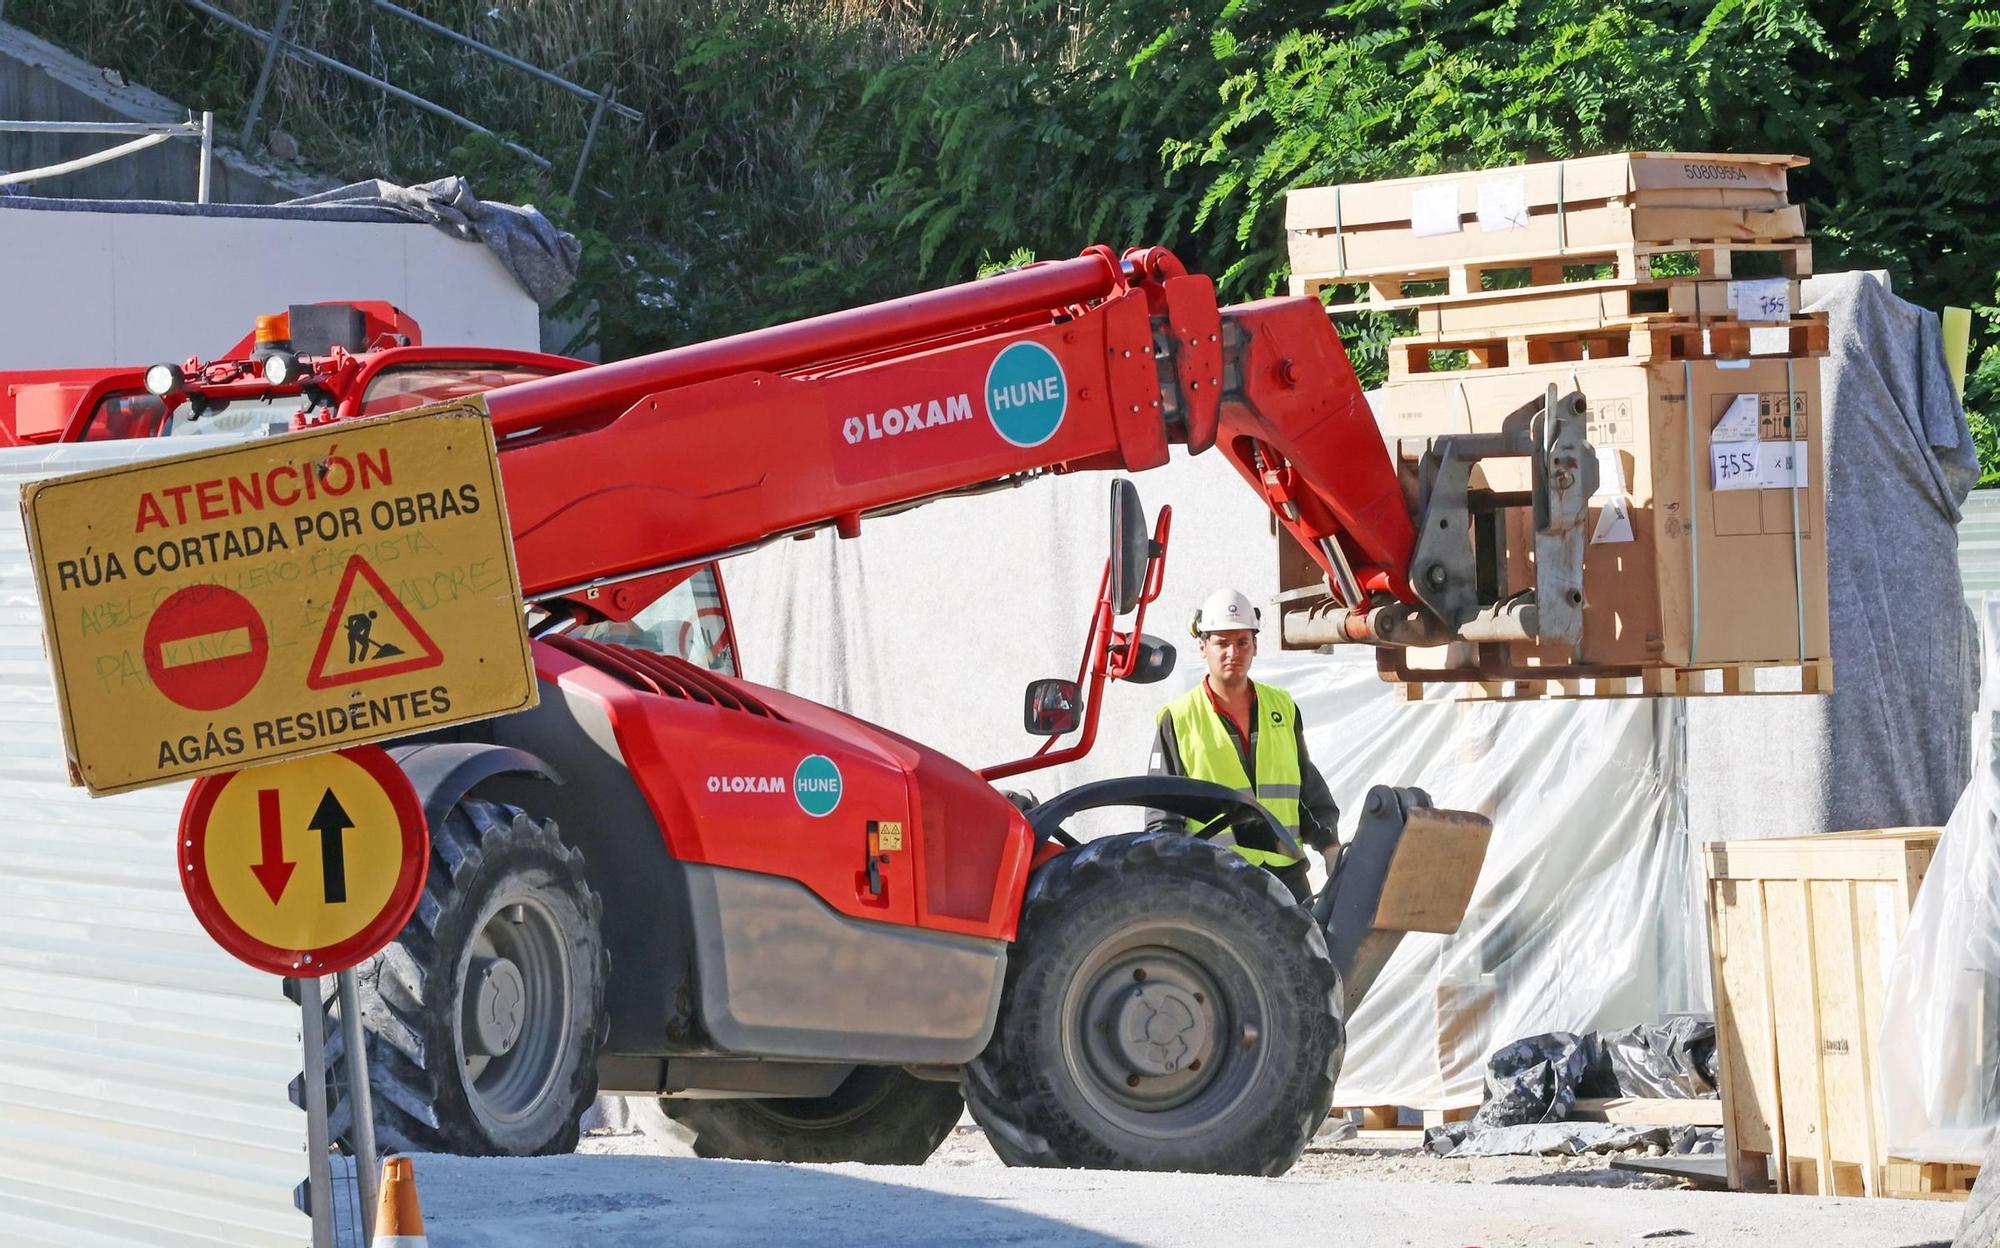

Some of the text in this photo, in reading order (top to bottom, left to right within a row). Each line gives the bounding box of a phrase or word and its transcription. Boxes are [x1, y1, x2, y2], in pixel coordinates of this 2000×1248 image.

[1683, 164, 1747, 181] 50809554
[993, 376, 1060, 411] HUNE
[866, 393, 973, 440] LOXAM
[1718, 453, 1754, 478] 755
[135, 444, 393, 534] ATENCIÓN
[58, 483, 480, 591] RÚA CORTADA POR OBRAS
[157, 685, 452, 769] AGÁS RESIDENTES
[722, 776, 786, 793] LOXAM
[798, 777, 838, 792] HUNE
